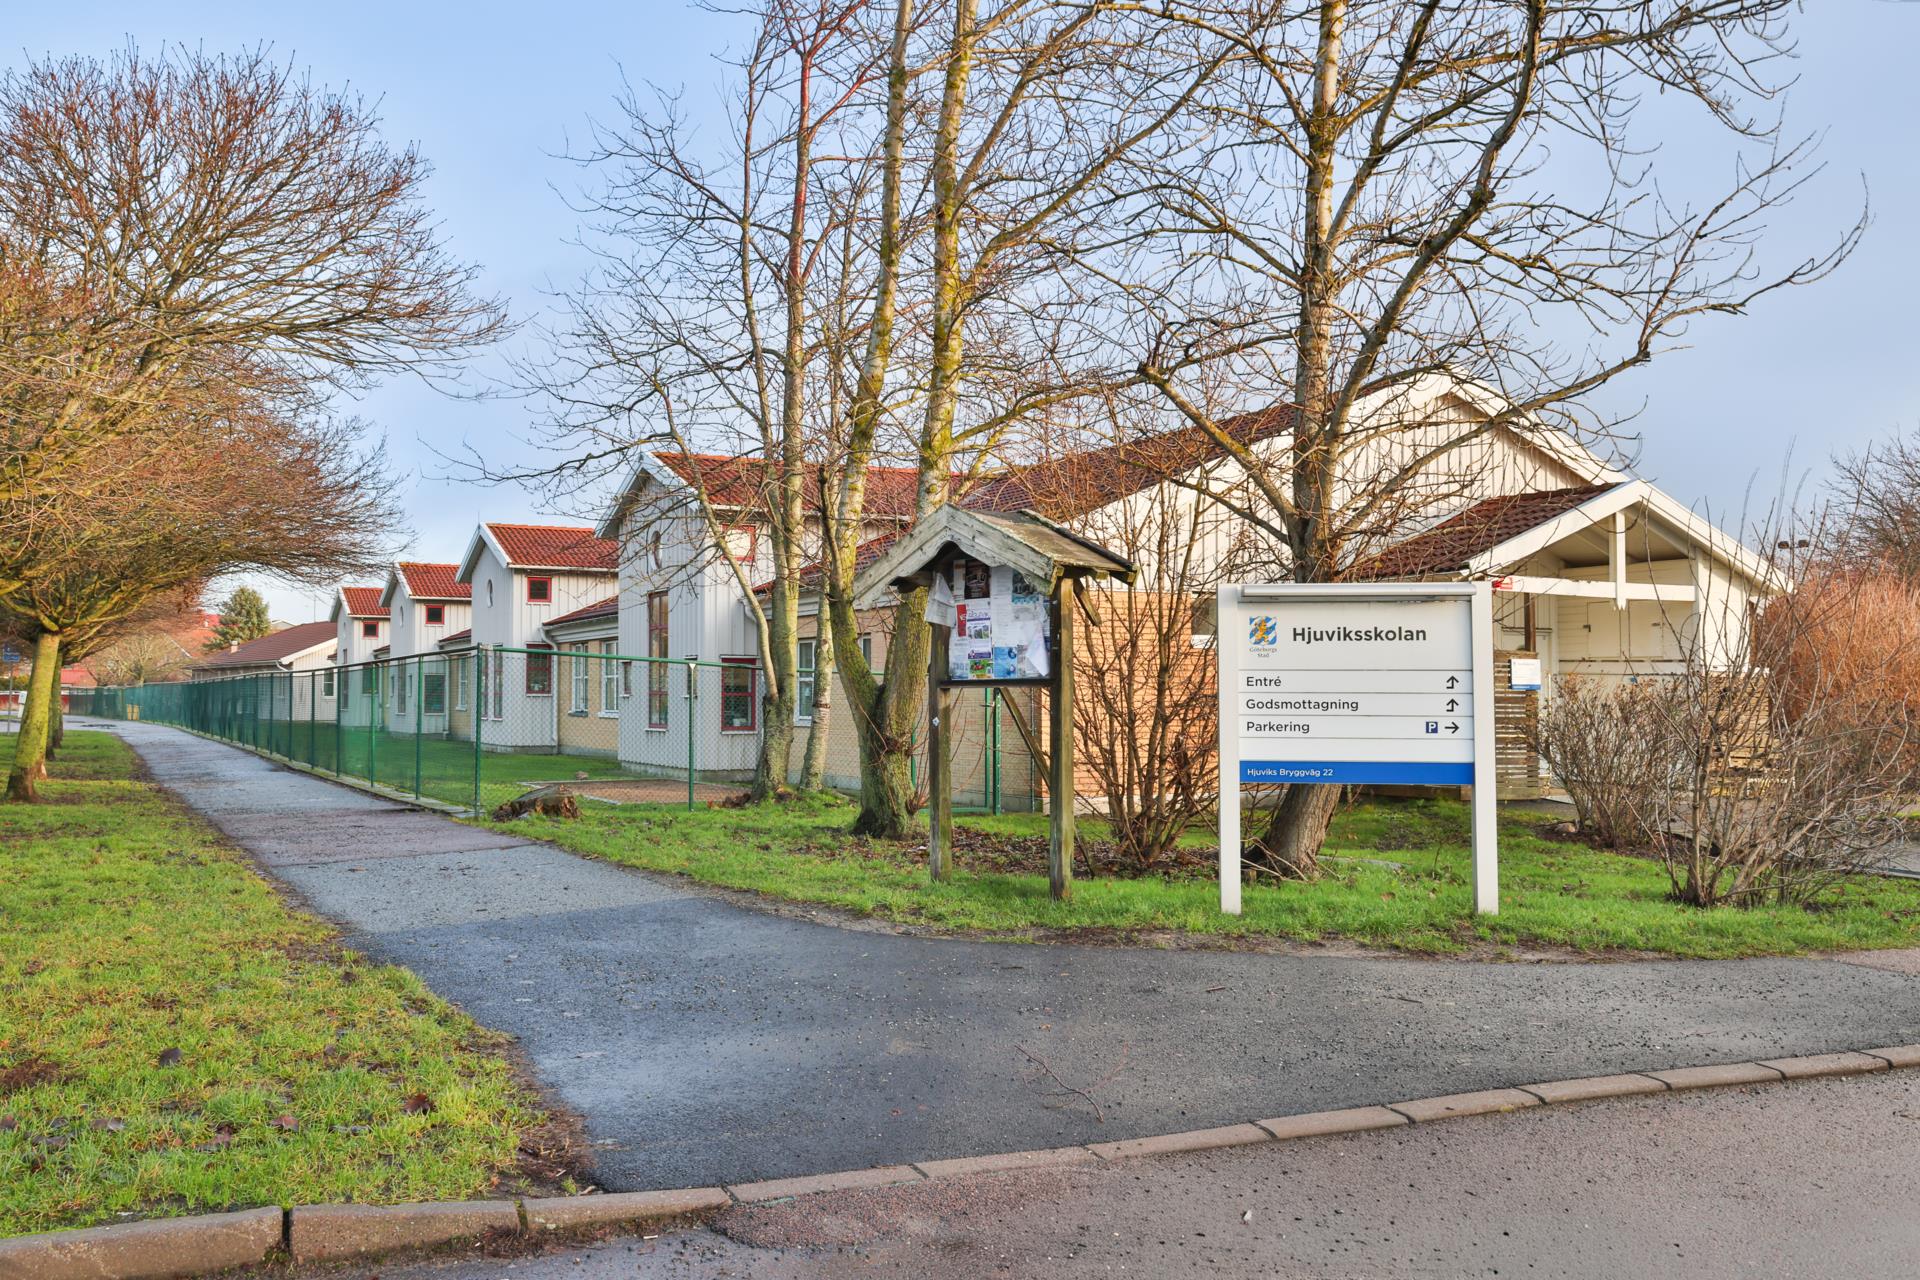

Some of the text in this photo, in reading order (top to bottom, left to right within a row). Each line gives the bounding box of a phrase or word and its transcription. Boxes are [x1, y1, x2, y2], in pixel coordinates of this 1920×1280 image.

[1292, 626, 1427, 644] Hjuviksskolan
[1246, 676, 1282, 687] Entré
[1246, 699, 1359, 711] Godsmottagning
[1246, 721, 1310, 733] Parkering
[1428, 723, 1436, 732] P
[1247, 768, 1333, 777] Hjuviks Bryggväg 22
